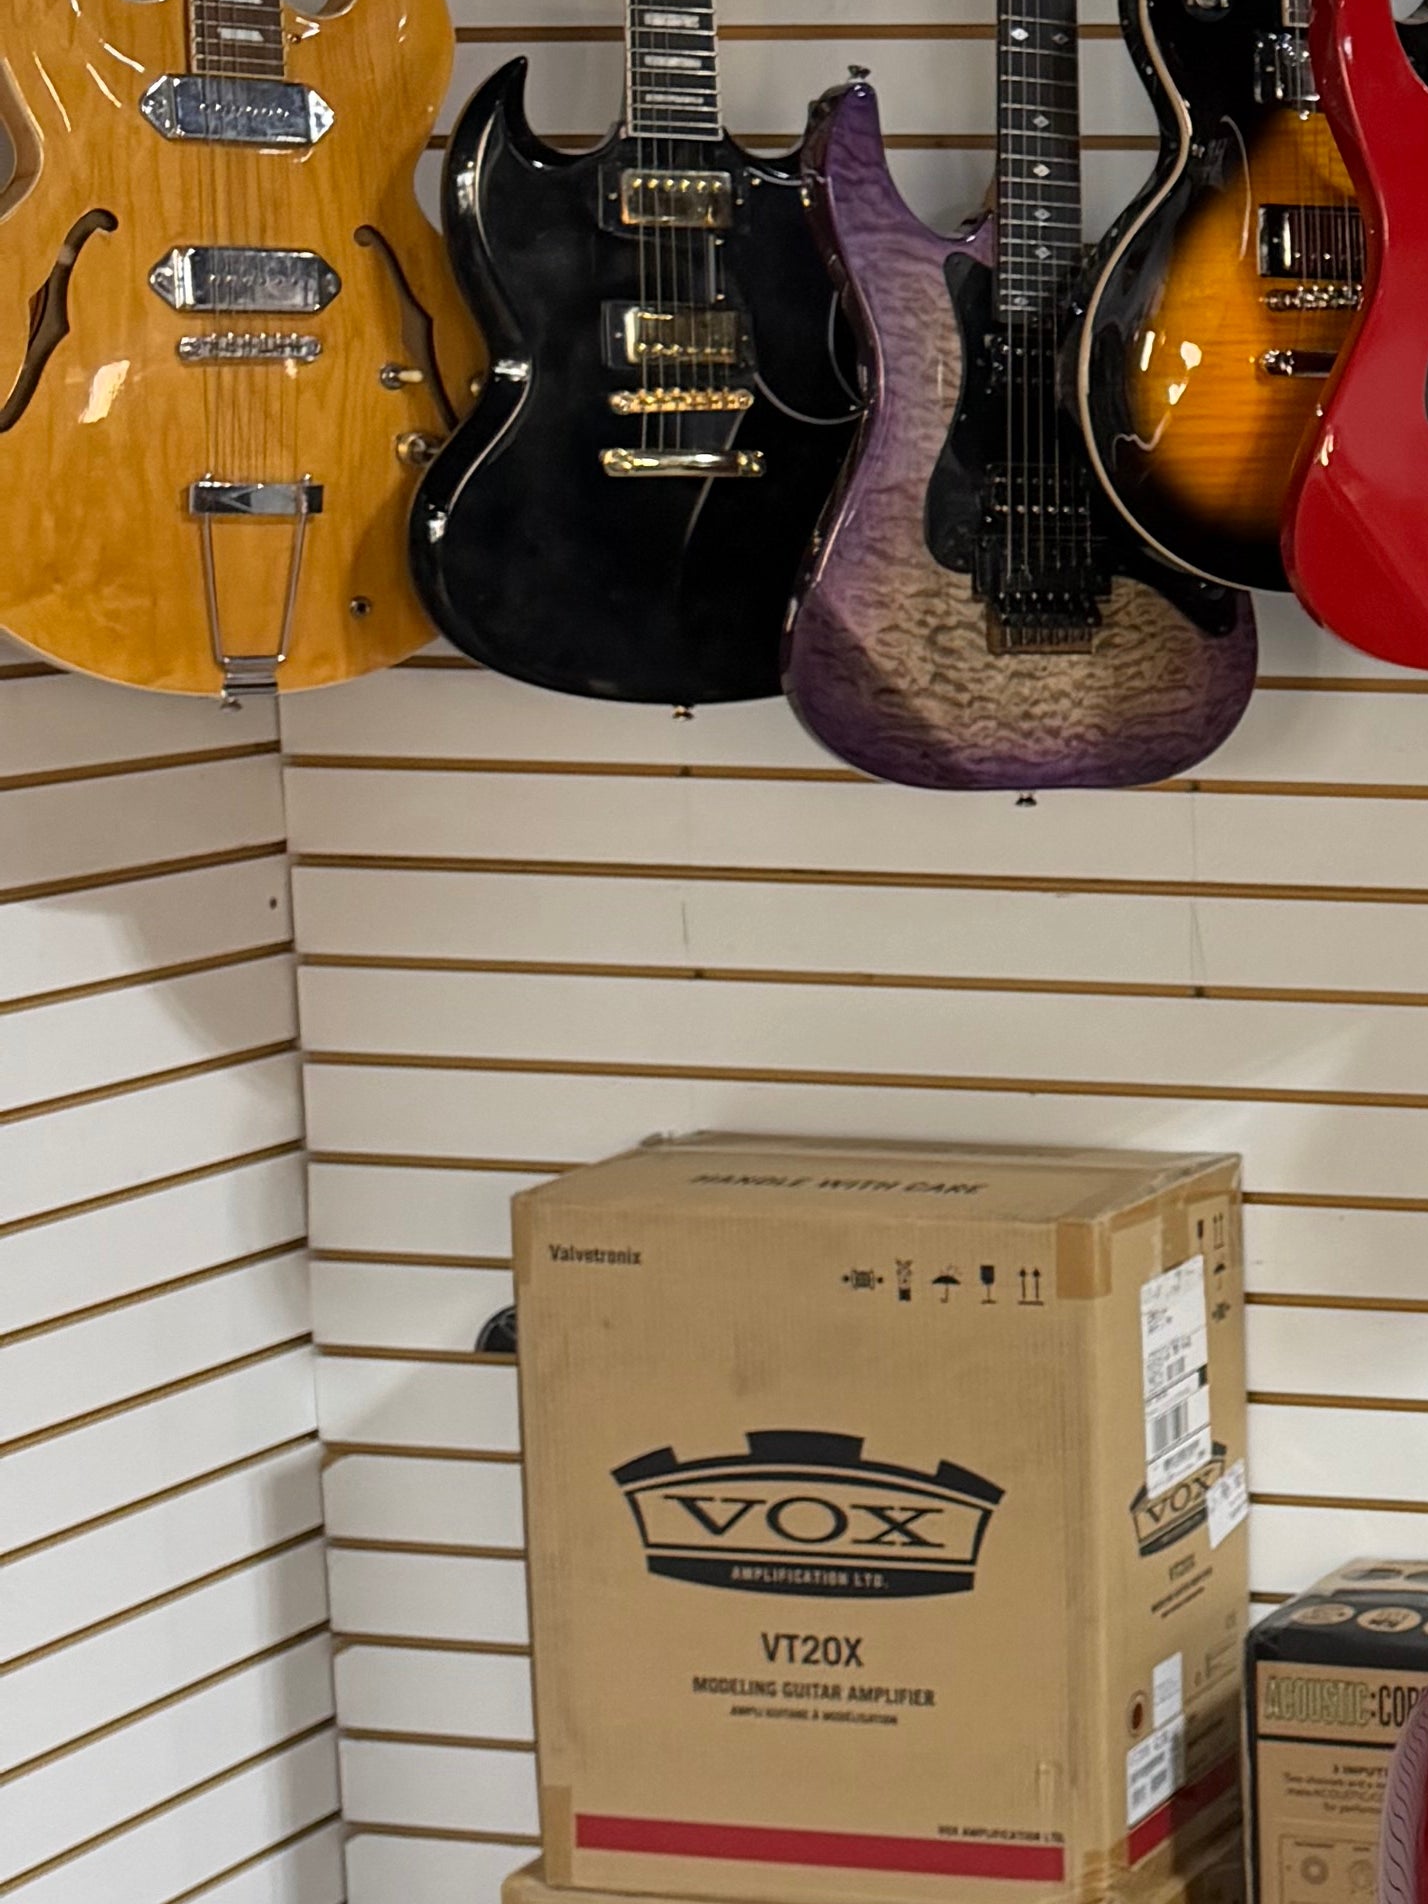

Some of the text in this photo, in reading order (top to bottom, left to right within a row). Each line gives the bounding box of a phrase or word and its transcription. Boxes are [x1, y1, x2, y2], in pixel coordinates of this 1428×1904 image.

[690, 1173, 991, 1196] HANDLE WITH CARE
[548, 1243, 643, 1266] Valvetronix
[662, 1493, 946, 1549] VOX
[731, 1565, 890, 1590] AMPLIFICATION LTD.
[760, 1631, 865, 1669] VT20X
[692, 1675, 937, 1708] MODELING GUITAR AMPLIFIER
[1264, 1674, 1427, 1728] ACOUSTIC:COR
